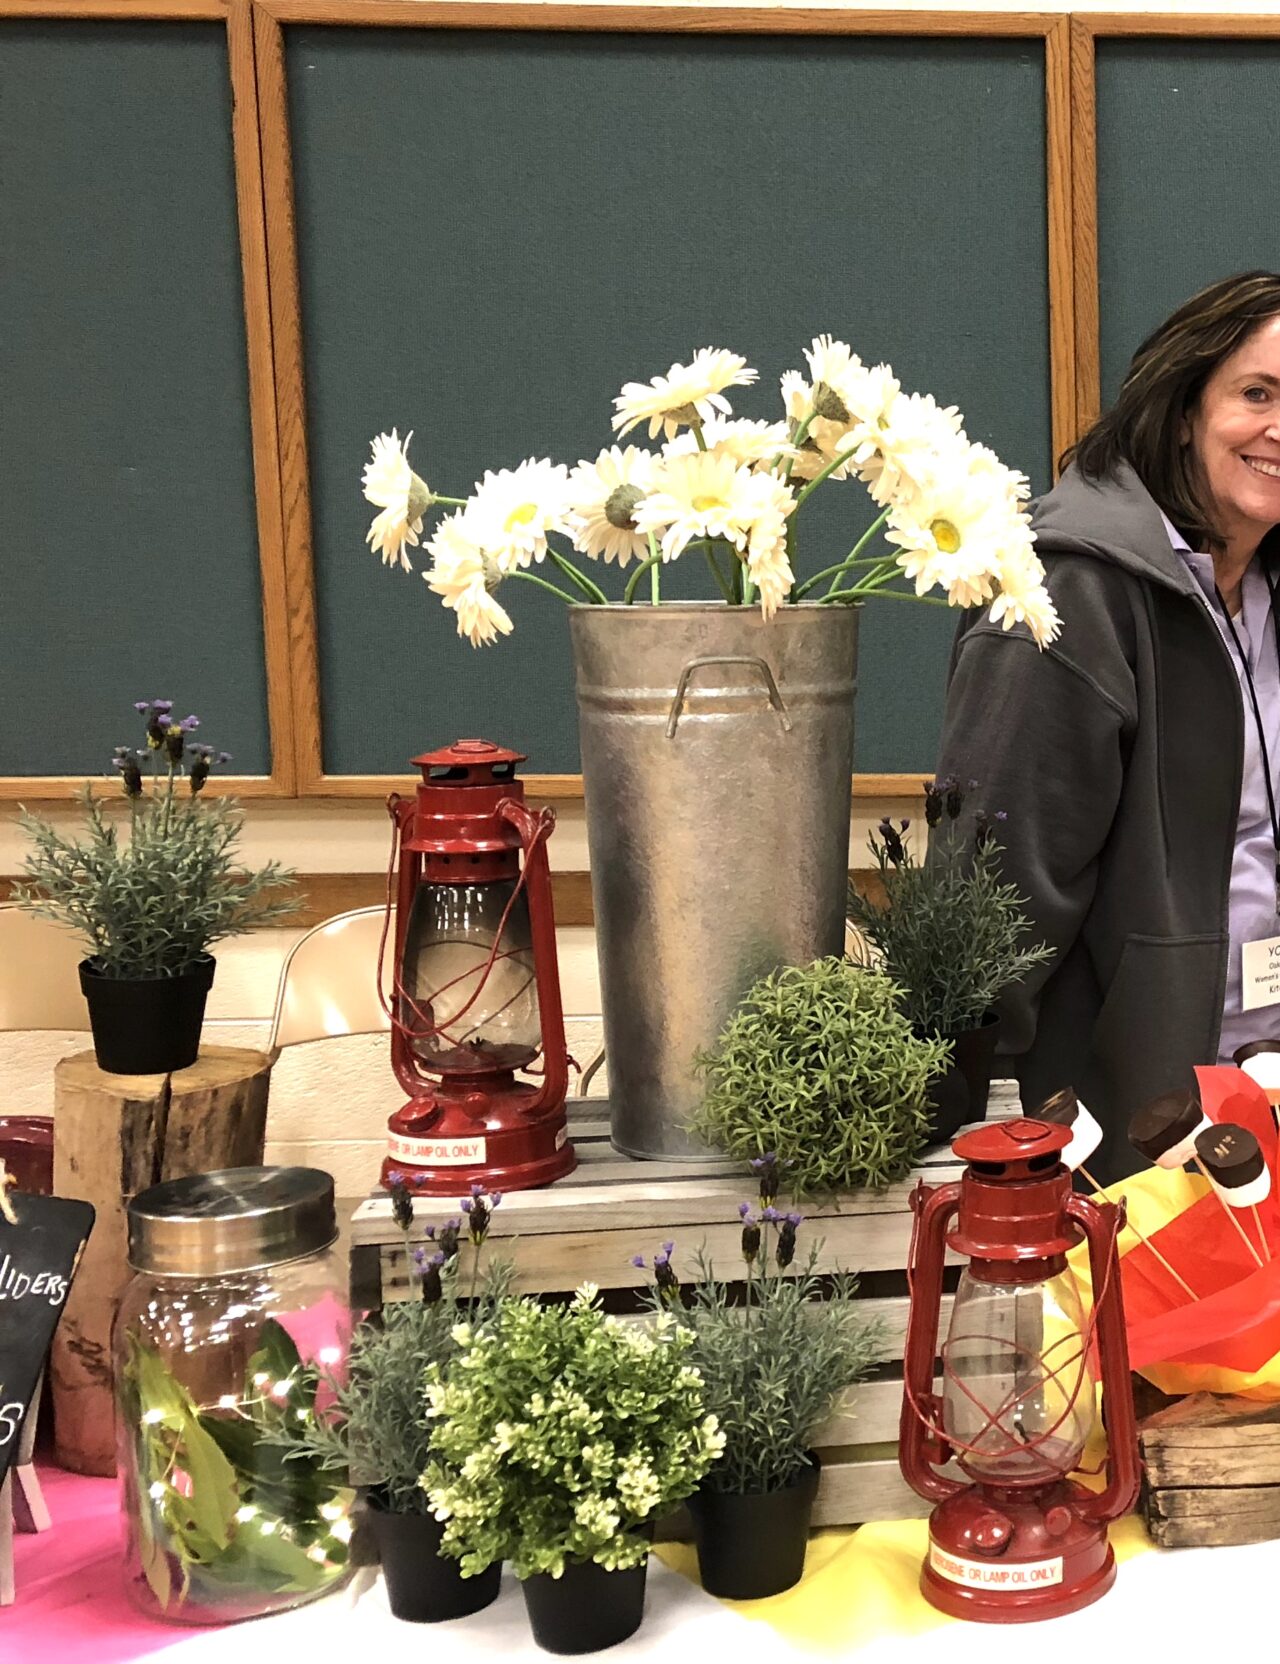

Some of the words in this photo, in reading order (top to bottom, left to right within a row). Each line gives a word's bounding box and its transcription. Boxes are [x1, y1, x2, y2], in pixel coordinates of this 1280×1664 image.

[412, 1145, 433, 1157] LAMP
[435, 1146, 450, 1158] OIL
[452, 1144, 479, 1158] ONLY
[0, 1253, 68, 1306] LIDERS
[968, 1568, 981, 1581] OR
[983, 1571, 1010, 1583] LAMP
[1011, 1571, 1028, 1583] OIL
[1029, 1567, 1057, 1583] ONLY
